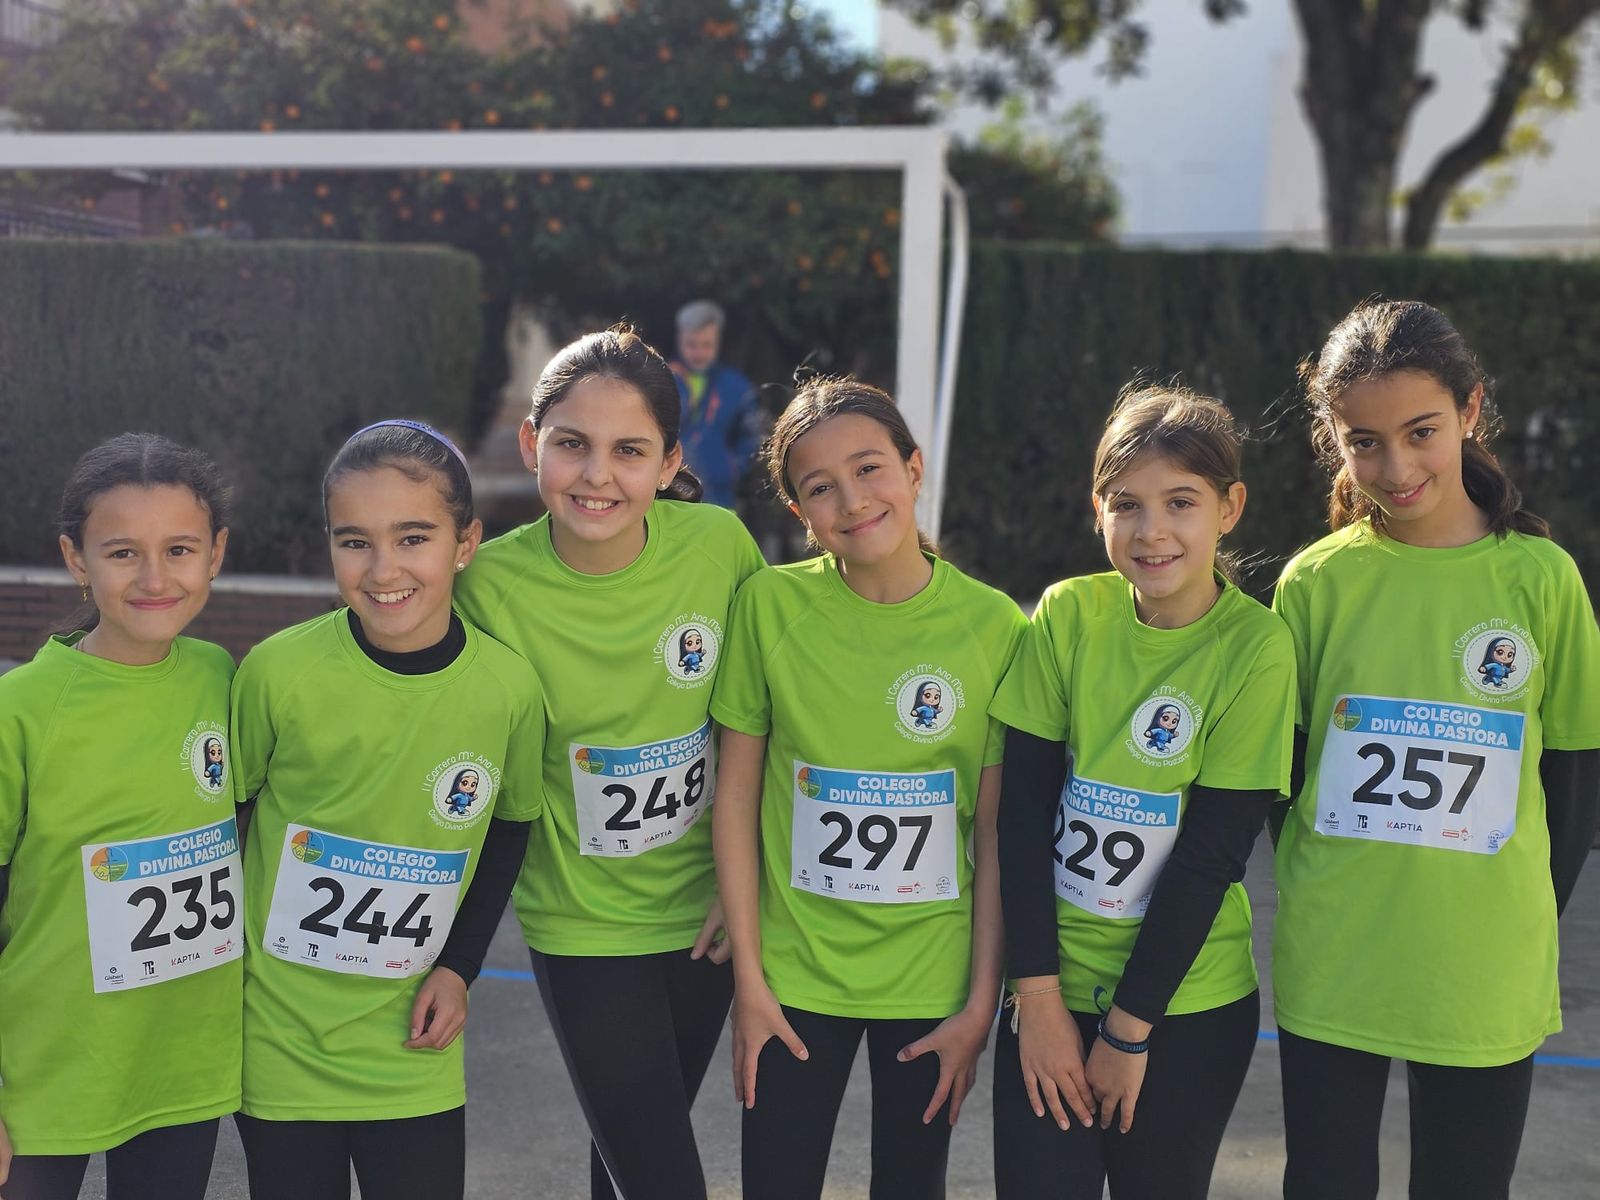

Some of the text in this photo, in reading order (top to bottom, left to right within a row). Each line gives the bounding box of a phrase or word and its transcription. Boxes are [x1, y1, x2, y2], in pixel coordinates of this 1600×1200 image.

[1404, 704, 1481, 727] COLEGIO
[1371, 718, 1508, 747] DIVINA PASTORA
[639, 732, 701, 760] COLEGIO
[614, 758, 666, 776] DIVINA
[1353, 742, 1486, 815] 257
[601, 757, 706, 831] 248
[857, 776, 927, 792] COLEGIO
[1071, 781, 1140, 808] COLEGIO
[829, 788, 948, 805] DIVINA PASTORA
[1094, 803, 1167, 825] PASTORA
[644, 829, 673, 844] KAPTIA
[1387, 821, 1423, 832] KAPTIA
[168, 828, 222, 854] COLEGIO
[818, 811, 933, 871] 297
[139, 838, 236, 876] DIVINA PASTORA
[330, 855, 457, 883] DIVINA PASTORA
[363, 847, 437, 868] COLEGIO
[848, 882, 881, 892] KAPTIA
[127, 866, 235, 952] 235
[299, 876, 433, 948] 244
[171, 952, 201, 966] KAPTIA
[335, 952, 369, 964] KAPTIA
